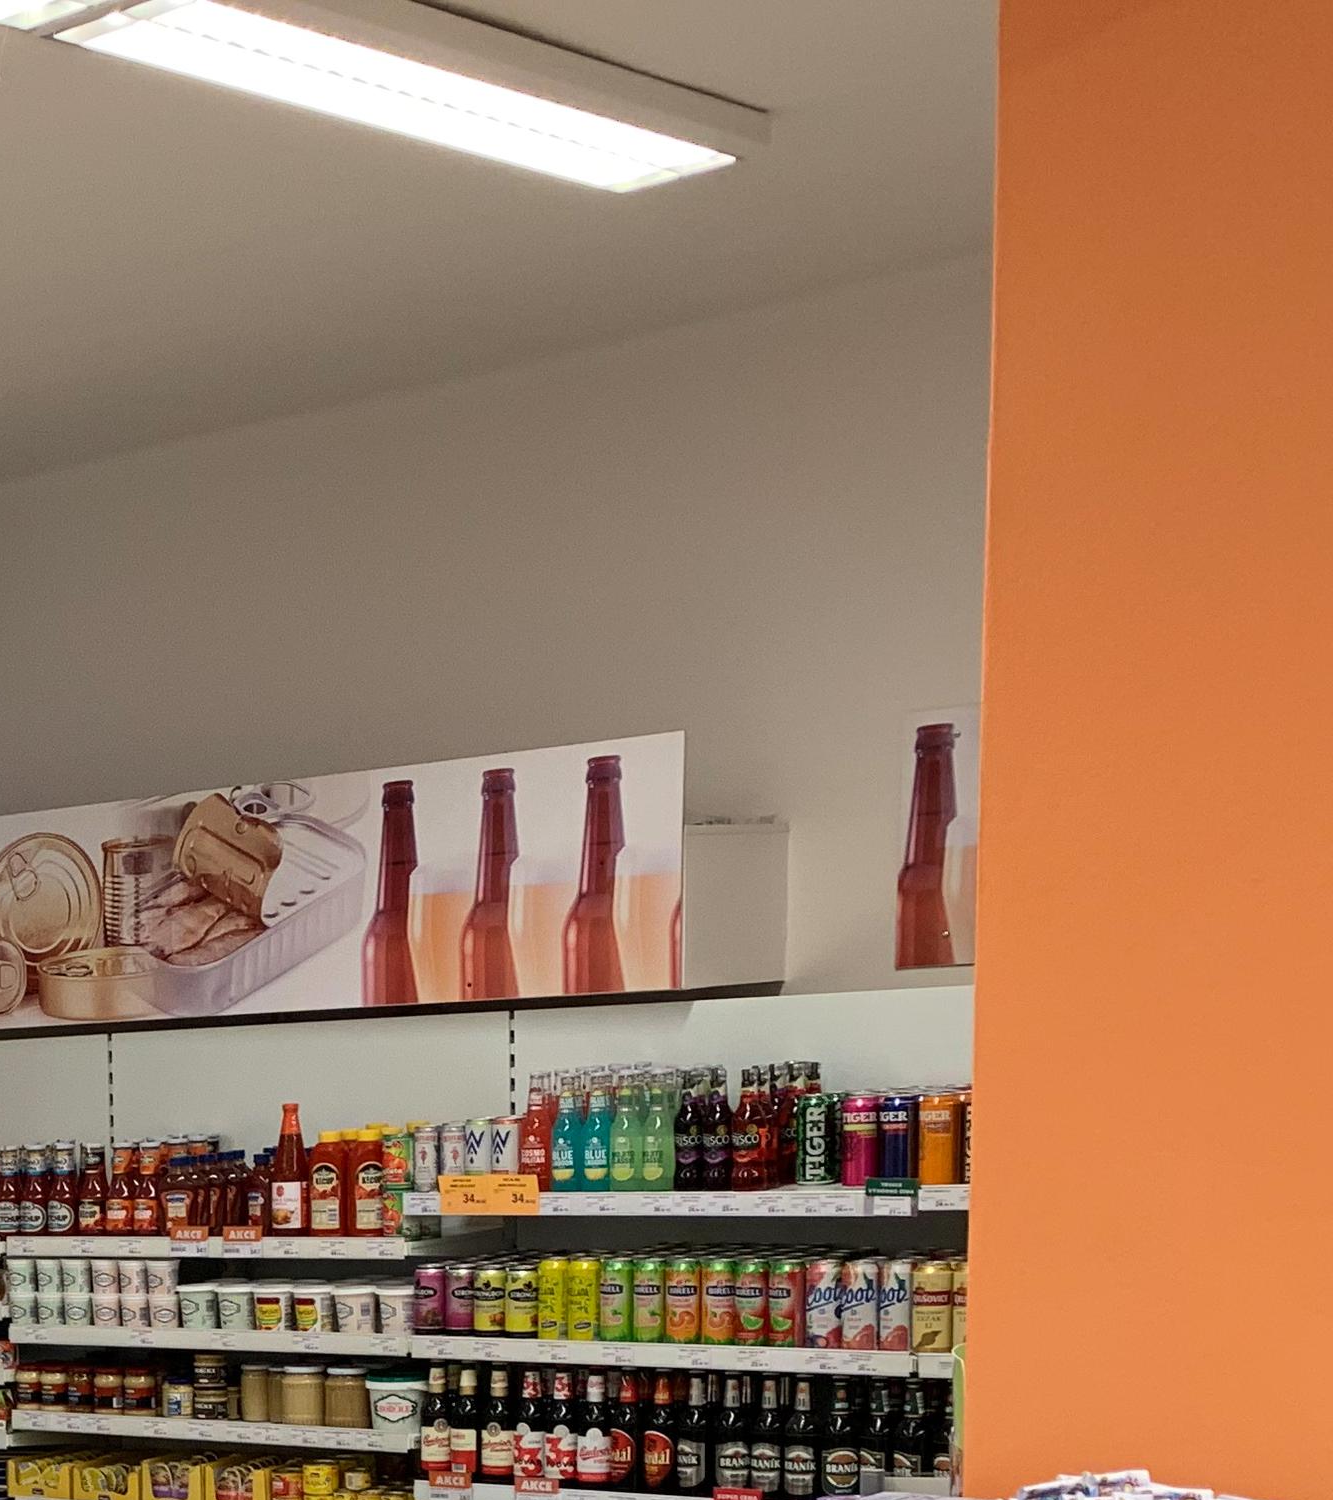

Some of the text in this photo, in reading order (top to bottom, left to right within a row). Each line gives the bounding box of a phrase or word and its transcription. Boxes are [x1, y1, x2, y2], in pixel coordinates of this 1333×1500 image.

[880, 1111, 908, 1122] GER
[805, 1104, 826, 1180] TIGER
[175, 1230, 203, 1240] AKCE
[228, 1230, 256, 1240] AKCE
[436, 1476, 465, 1486] AKCE
[521, 1480, 552, 1491] AKCE
